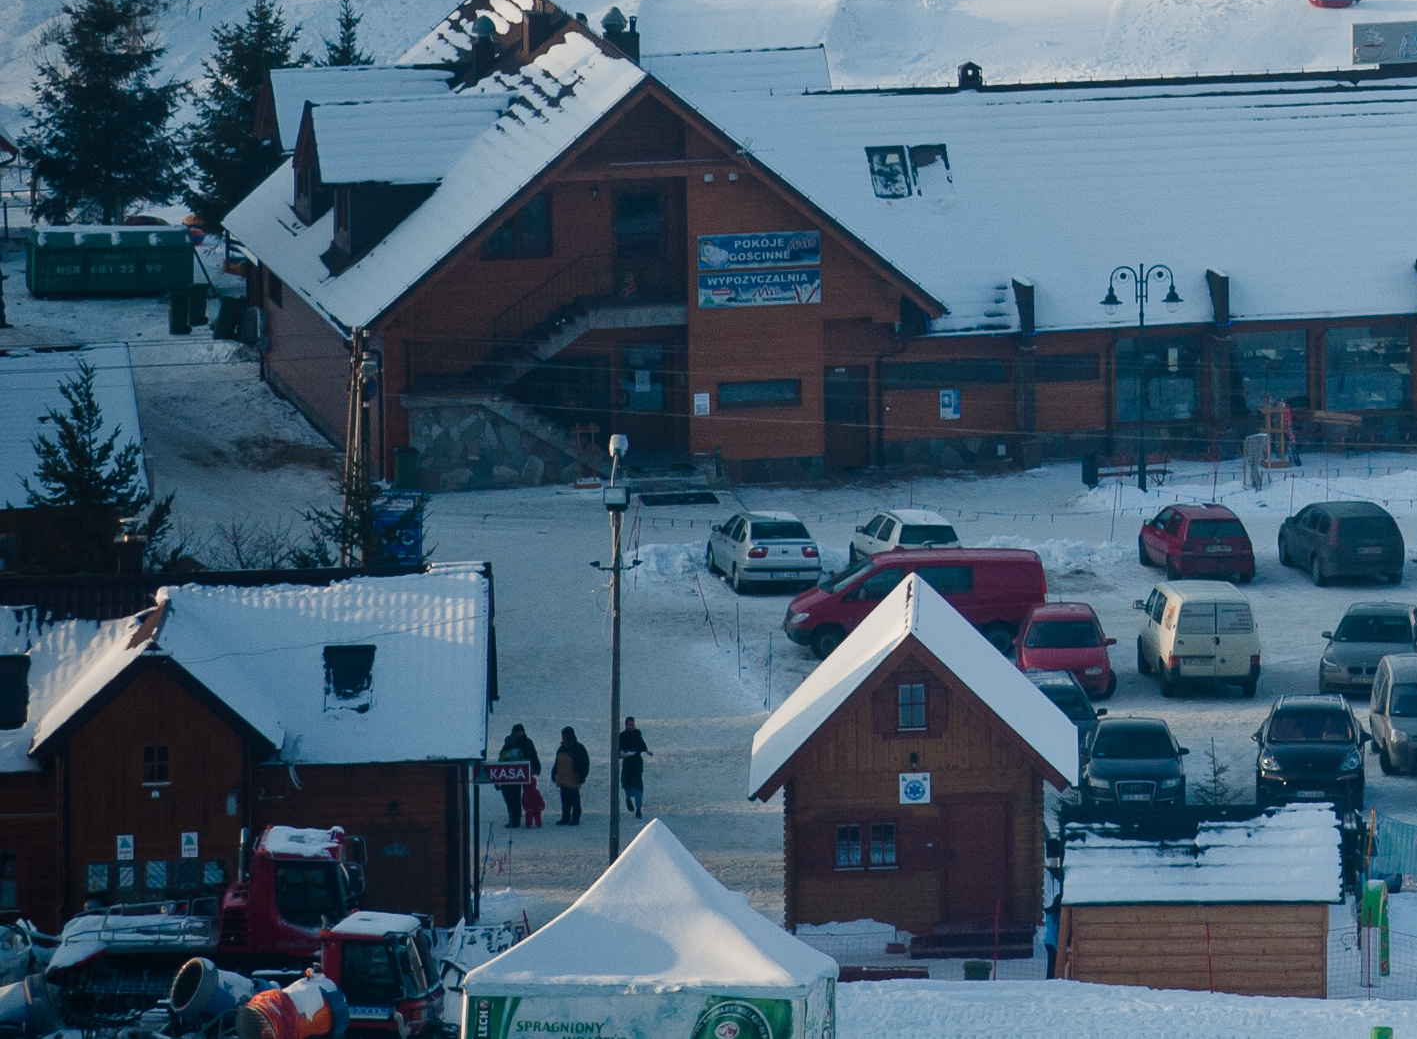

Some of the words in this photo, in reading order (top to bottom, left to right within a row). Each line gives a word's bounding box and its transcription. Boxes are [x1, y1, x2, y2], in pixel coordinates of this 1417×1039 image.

[734, 238, 784, 249] POKOJE
[729, 251, 791, 262] GOŚCINNE
[490, 768, 526, 780] KASA
[478, 1010, 489, 1038] LECH
[516, 1020, 604, 1034] SPRAGNIONY
